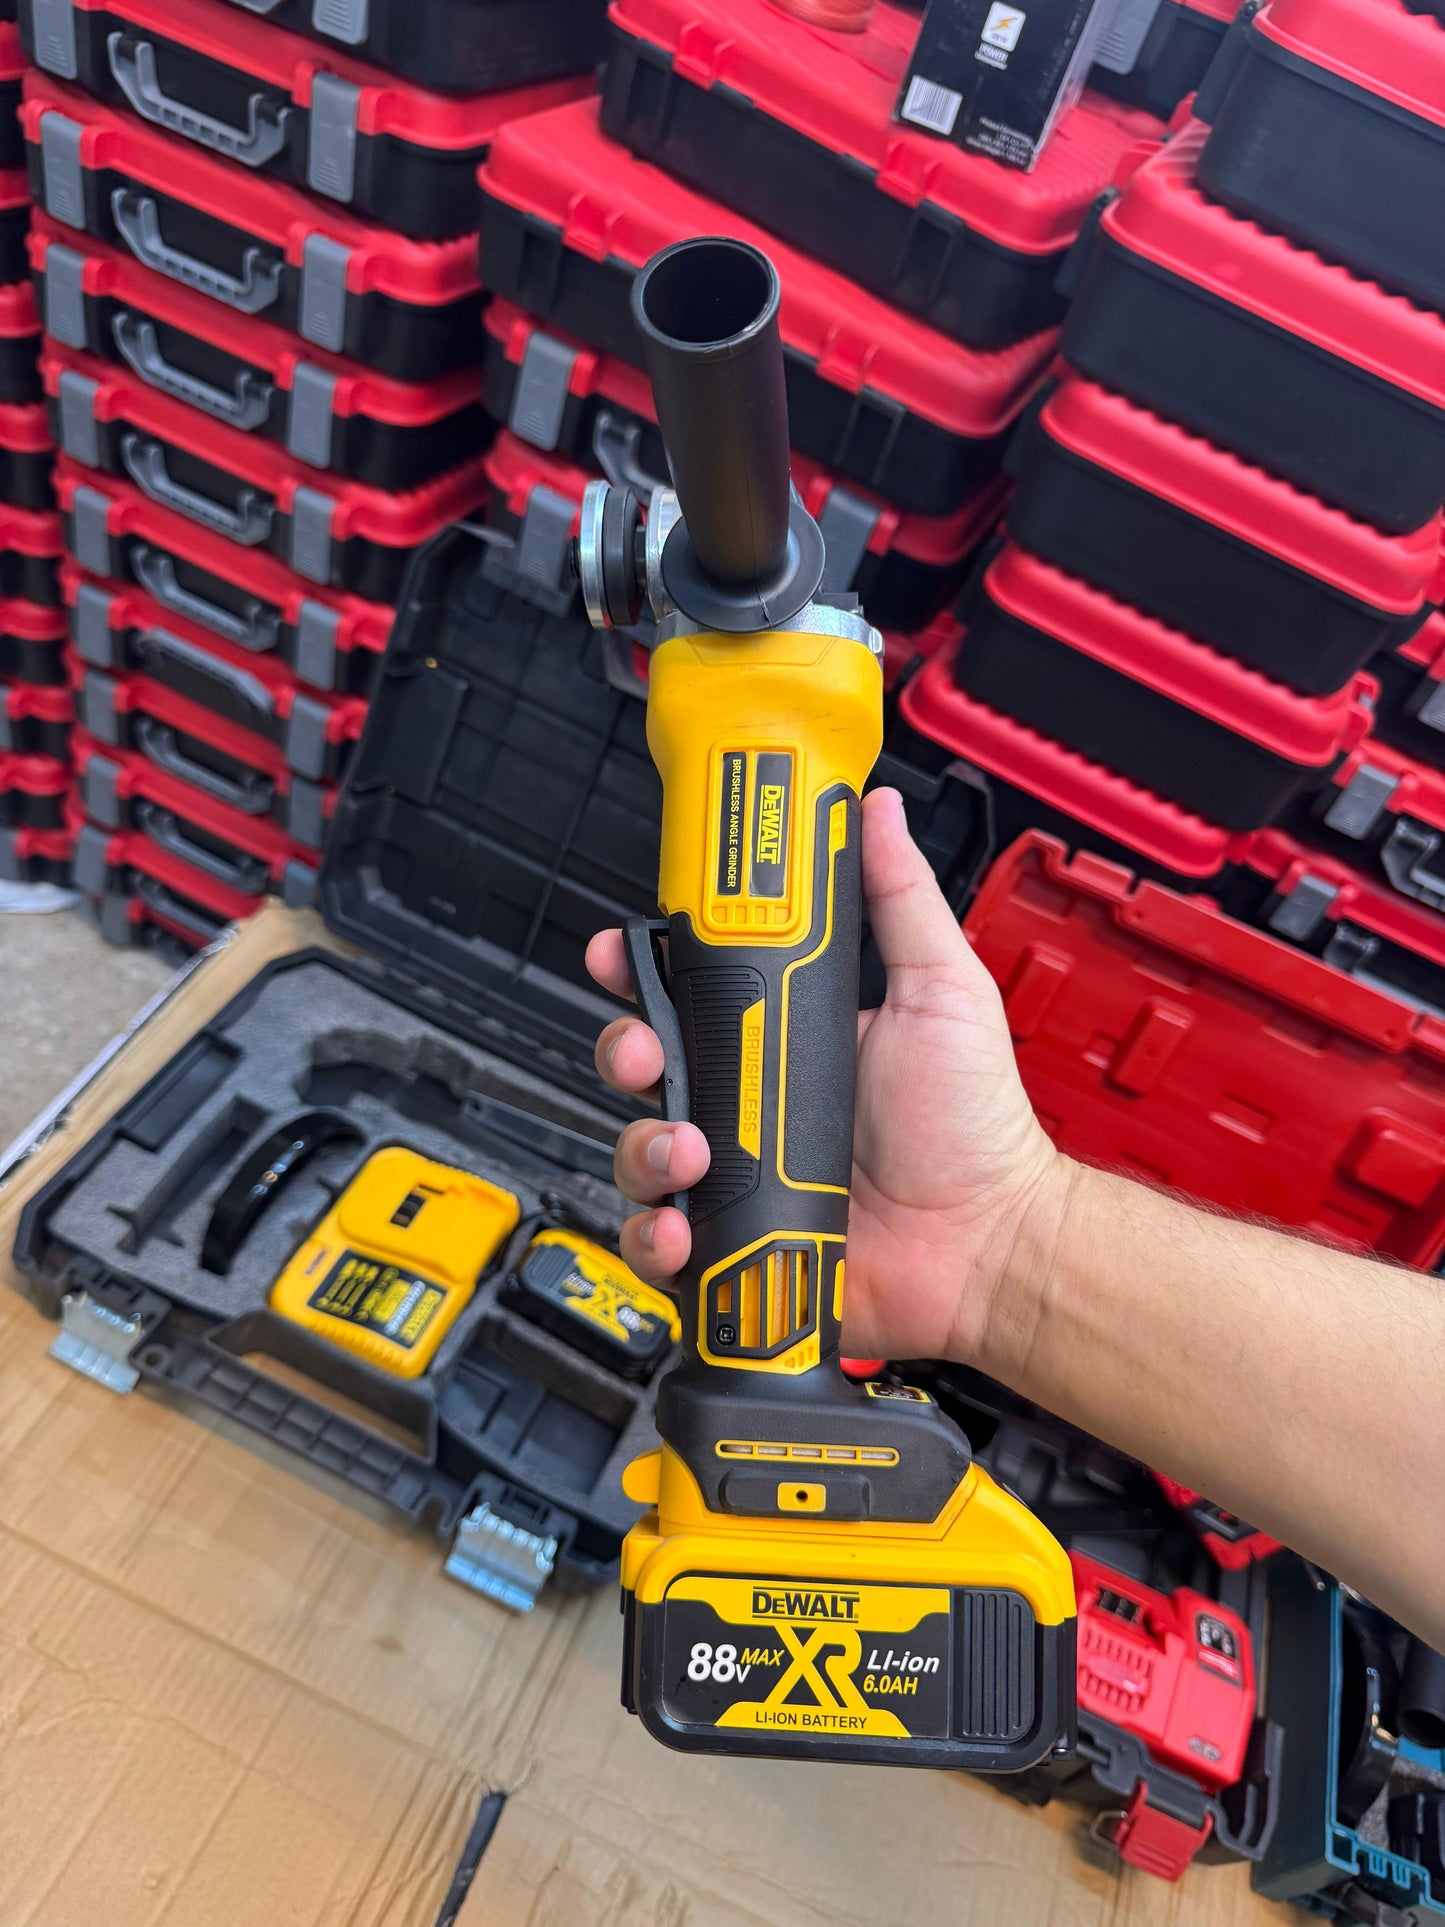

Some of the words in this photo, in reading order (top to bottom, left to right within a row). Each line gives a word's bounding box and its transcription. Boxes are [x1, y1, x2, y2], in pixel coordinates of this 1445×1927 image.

[730, 759, 742, 813] BRUSHLESS
[729, 814, 740, 845] ANGLE
[760, 785, 782, 865] DEWALT
[727, 848, 738, 888] GRINDER
[743, 1026, 760, 1133] BRUSHLESS
[752, 1590, 860, 1619] DEWALT
[740, 1647, 785, 1667] MAX
[764, 1625, 869, 1709] XR
[863, 1674, 919, 1695] 6.0AH
[755, 1711, 797, 1725] LI-ION
[802, 1714, 868, 1729] BATTERY
